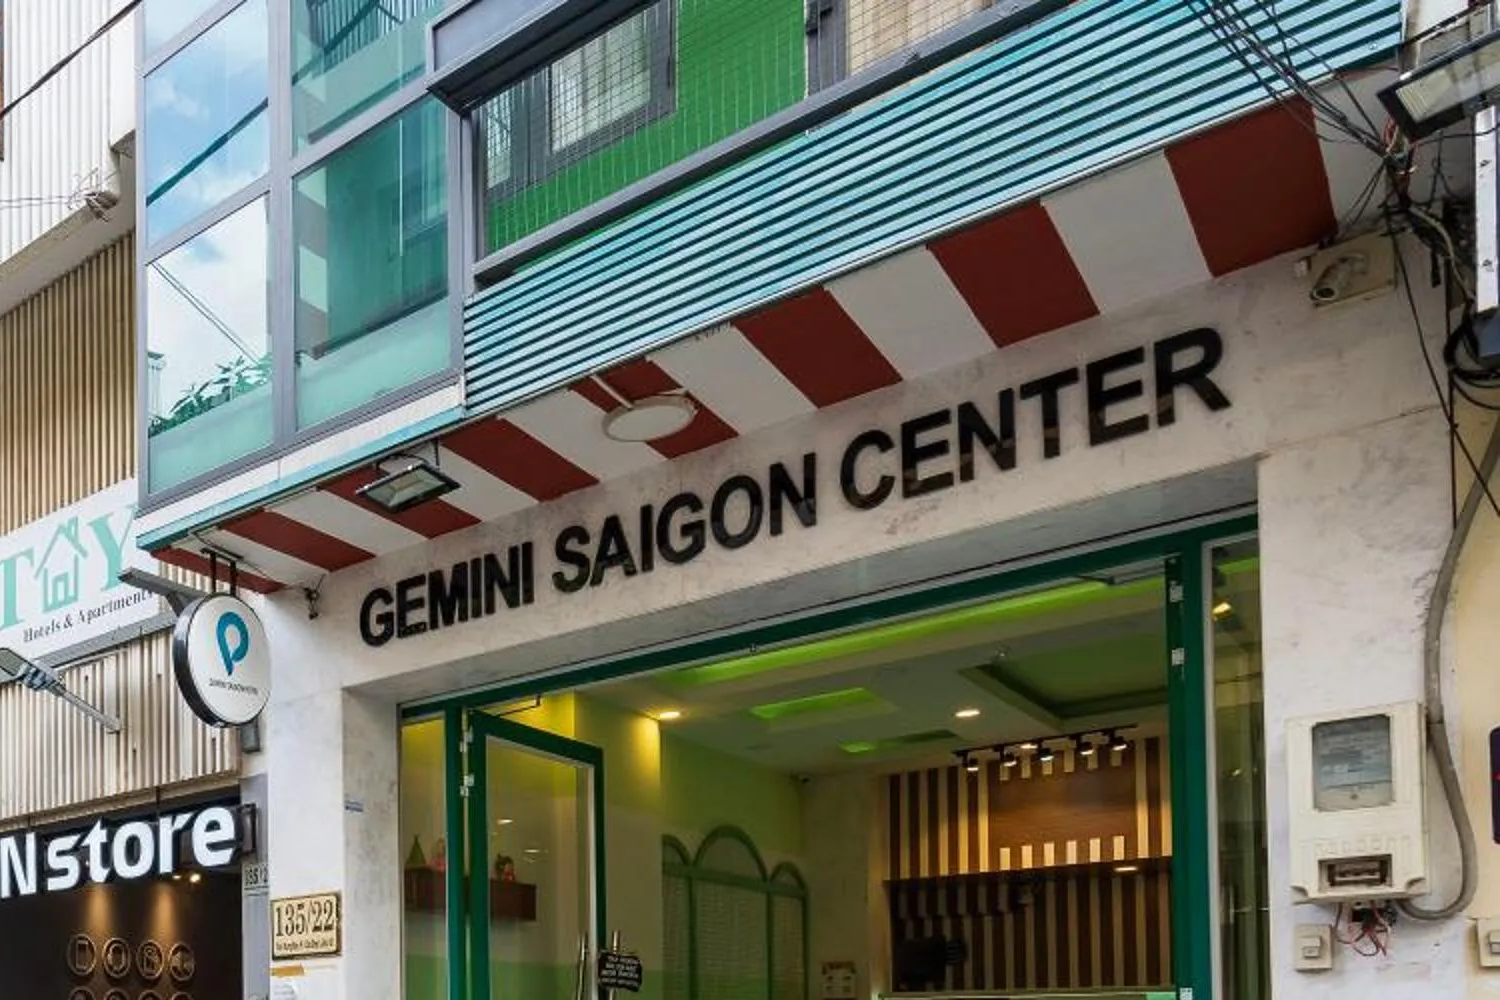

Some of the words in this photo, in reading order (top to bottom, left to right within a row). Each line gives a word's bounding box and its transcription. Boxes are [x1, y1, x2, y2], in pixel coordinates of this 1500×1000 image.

[359, 542, 535, 648] GEMINI
[551, 452, 819, 594] SAIGON
[838, 326, 1235, 512] CENTER
[23, 618, 61, 643] Hotels
[63, 613, 73, 629] &
[275, 899, 335, 937] 135/22
